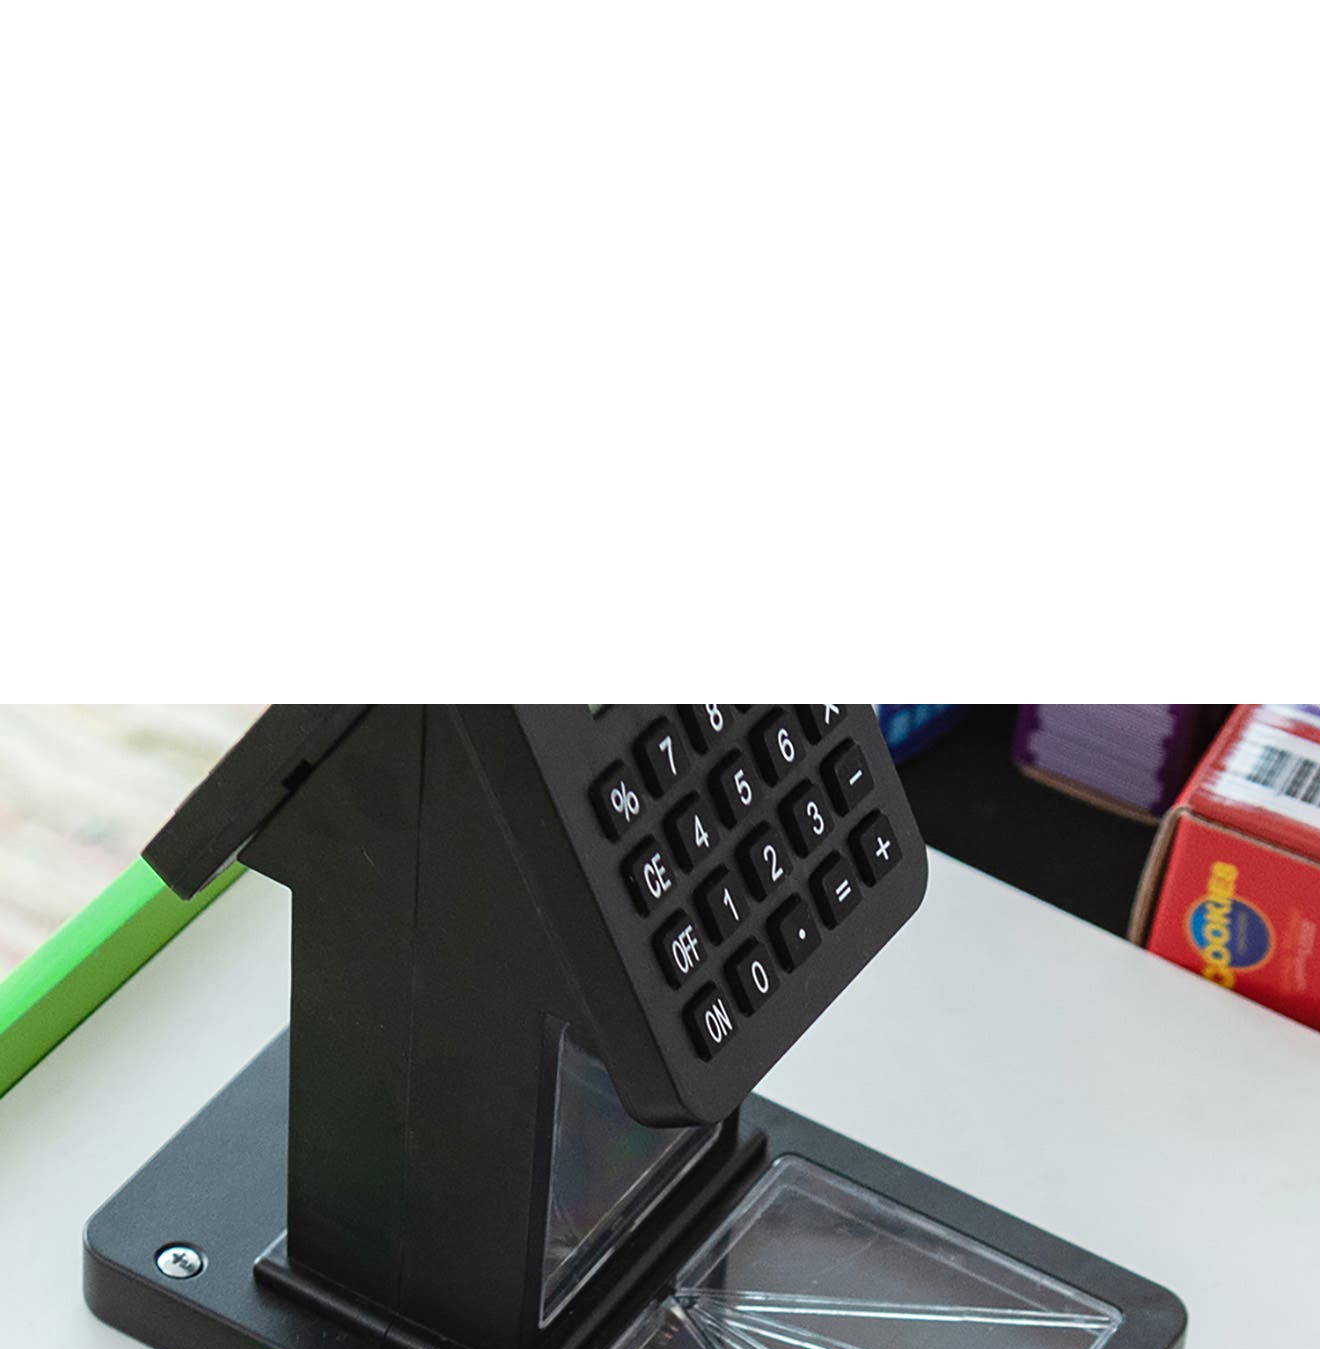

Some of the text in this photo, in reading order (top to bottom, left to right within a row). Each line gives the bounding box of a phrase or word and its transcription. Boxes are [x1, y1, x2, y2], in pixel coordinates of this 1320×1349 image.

[705, 704, 723, 732] 8
[658, 735, 678, 776] 7
[777, 728, 795, 762] 6
[610, 781, 640, 822] %
[733, 769, 752, 806] 5
[693, 815, 710, 848] 4
[806, 801, 825, 835] 3
[643, 853, 672, 899] CE
[763, 844, 784, 882] 2
[722, 888, 740, 921] 1
[671, 925, 701, 974] OFF
[705, 998, 734, 1044] ON
